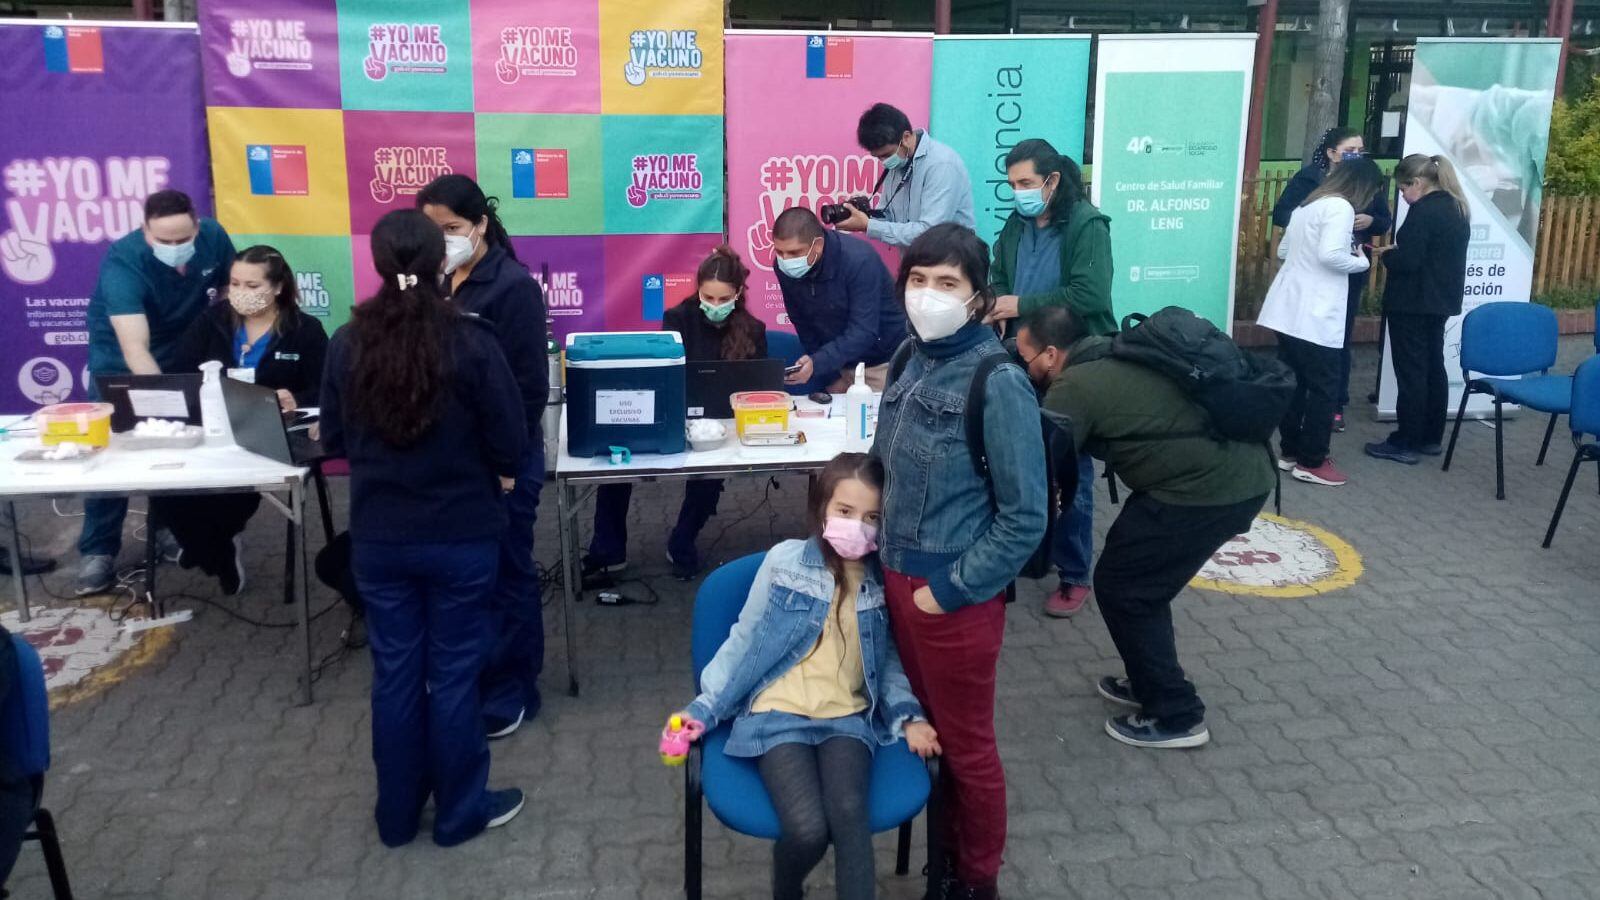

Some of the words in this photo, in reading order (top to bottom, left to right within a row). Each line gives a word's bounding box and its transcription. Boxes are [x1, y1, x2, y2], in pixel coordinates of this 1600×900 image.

[231, 19, 273, 39] #YO
[276, 20, 306, 40] ME
[370, 25, 409, 43] #YO
[413, 26, 440, 43] ME
[503, 28, 541, 46] #YO
[544, 28, 570, 46] ME
[231, 38, 312, 60] VACUNO
[631, 31, 668, 49] #YO
[671, 31, 697, 49] ME
[370, 43, 446, 62] VACUNO
[503, 46, 576, 66] VACUNO
[630, 49, 702, 68] VACUNO
[377, 149, 415, 167] #YO
[419, 149, 446, 166] ME
[633, 155, 668, 172] #YO
[672, 155, 697, 172] ME
[6, 157, 100, 202] #YO
[106, 157, 170, 200] ME
[633, 172, 702, 189] VACUNO
[763, 157, 837, 195] #YO
[1115, 182, 1145, 191] Centro
[1147, 181, 1159, 190] de
[1160, 180, 1186, 190] Salud
[1187, 179, 1225, 189] Familiar
[1127, 199, 1148, 212] DR.
[1150, 198, 1210, 212] ALFONSO
[9, 200, 145, 243] VACU
[1151, 217, 1184, 230] LENG
[1466, 263, 1484, 277] és
[1488, 264, 1506, 277] de
[296, 272, 323, 290] ME
[552, 272, 578, 290] ME
[1463, 282, 1503, 296] ación
[25, 298, 47, 307] Las
[48, 298, 90, 307] vacun
[294, 289, 329, 308] UNO
[548, 289, 583, 307] UNO
